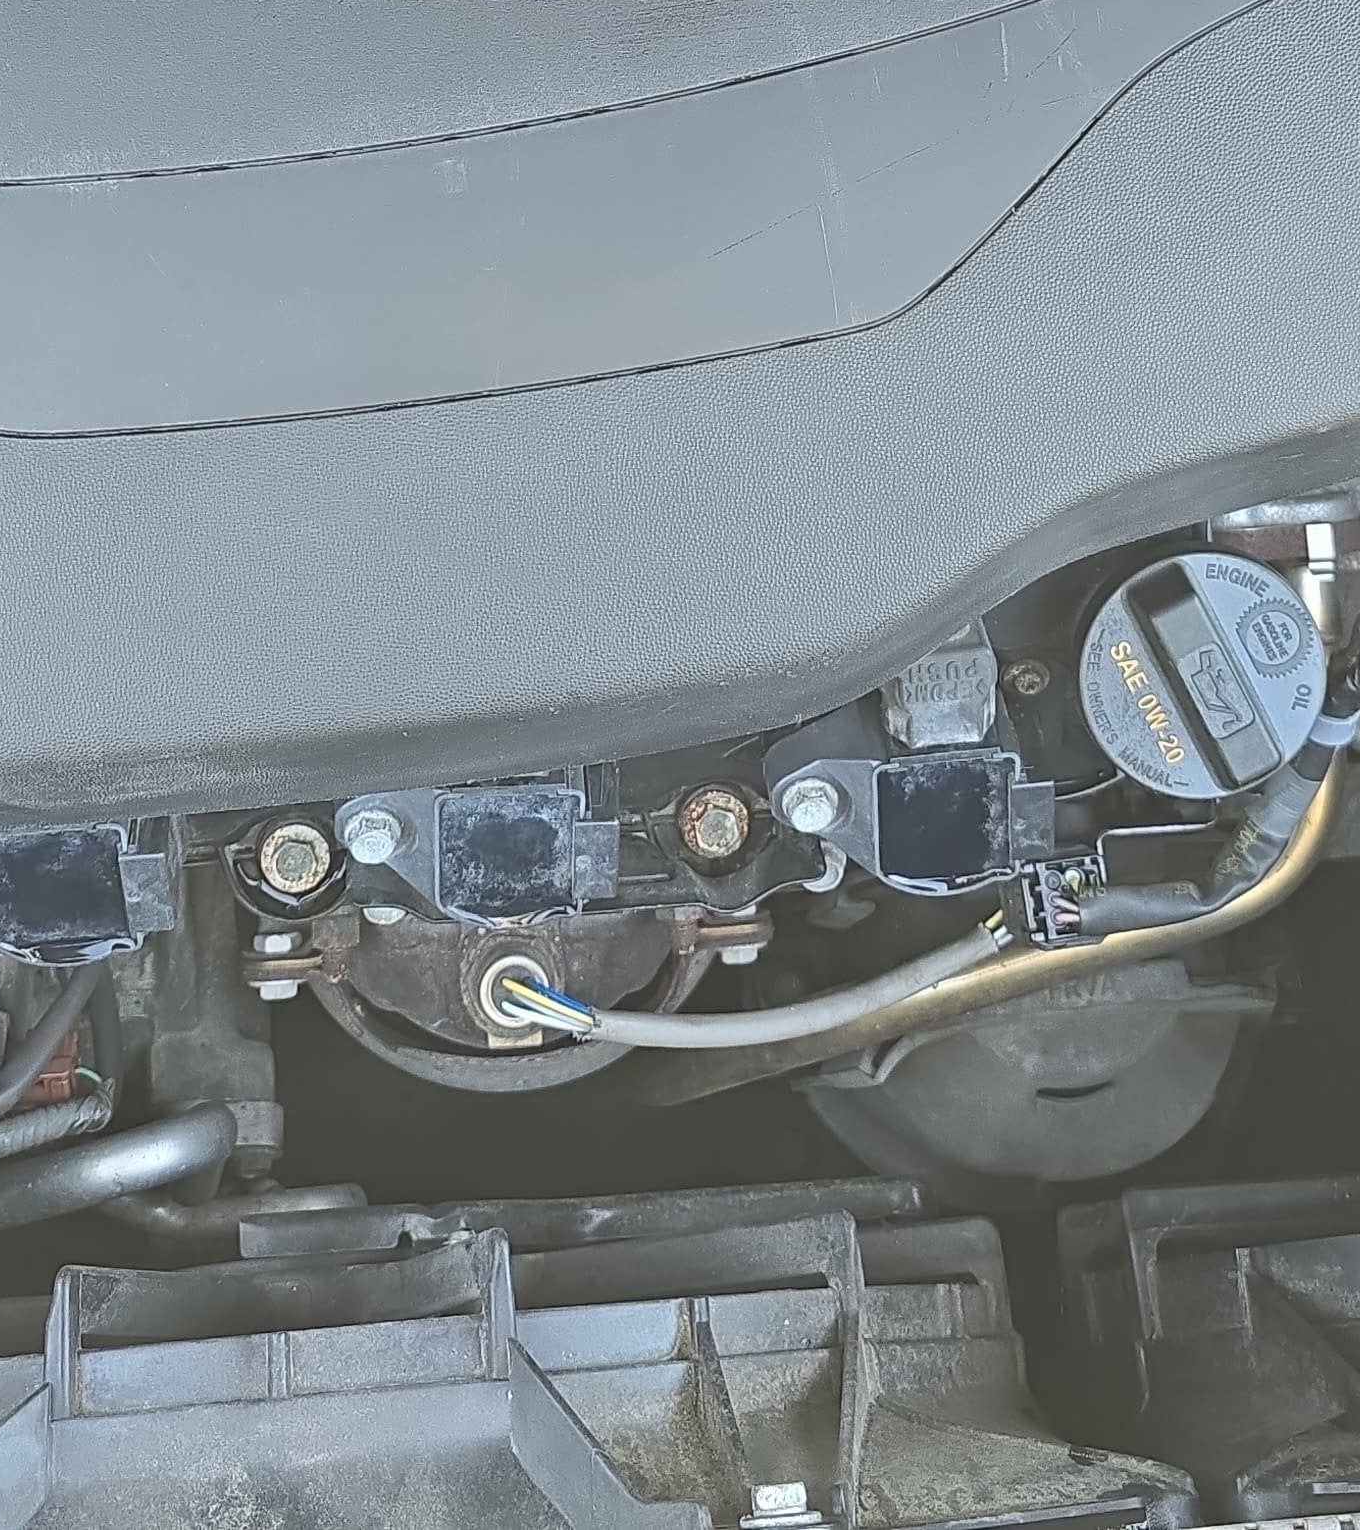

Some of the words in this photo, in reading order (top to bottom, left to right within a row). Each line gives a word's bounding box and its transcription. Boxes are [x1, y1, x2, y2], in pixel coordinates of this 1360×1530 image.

[1204, 563, 1271, 598] ENGINE
[1260, 614, 1290, 660] GASOLINE
[1277, 621, 1294, 642] FOR
[1110, 640, 1149, 694] SAE
[1136, 693, 1186, 764] 0W-20
[1291, 683, 1312, 711] OIL
